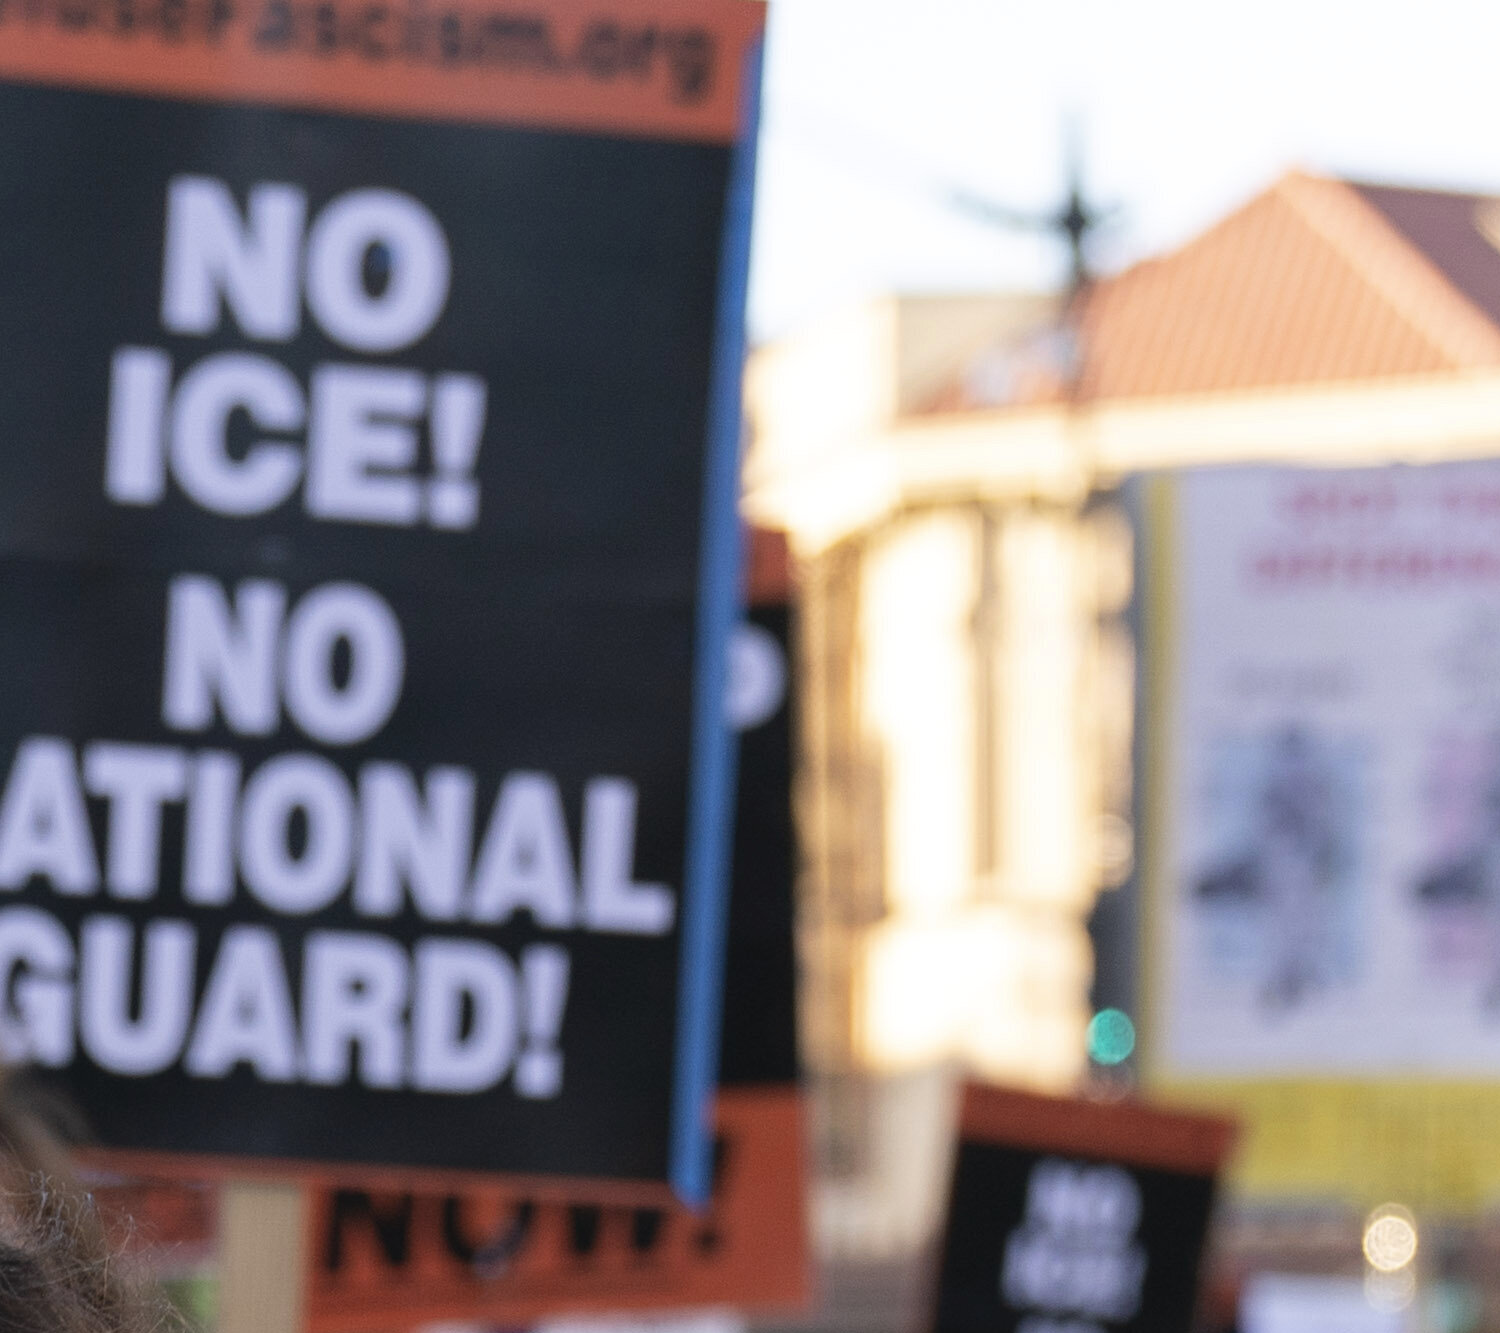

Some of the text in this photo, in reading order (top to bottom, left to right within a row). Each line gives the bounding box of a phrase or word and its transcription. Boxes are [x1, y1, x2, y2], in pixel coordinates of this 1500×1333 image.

[161, 176, 450, 351] NO
[105, 349, 485, 529] ICE!
[161, 575, 405, 744] NO
